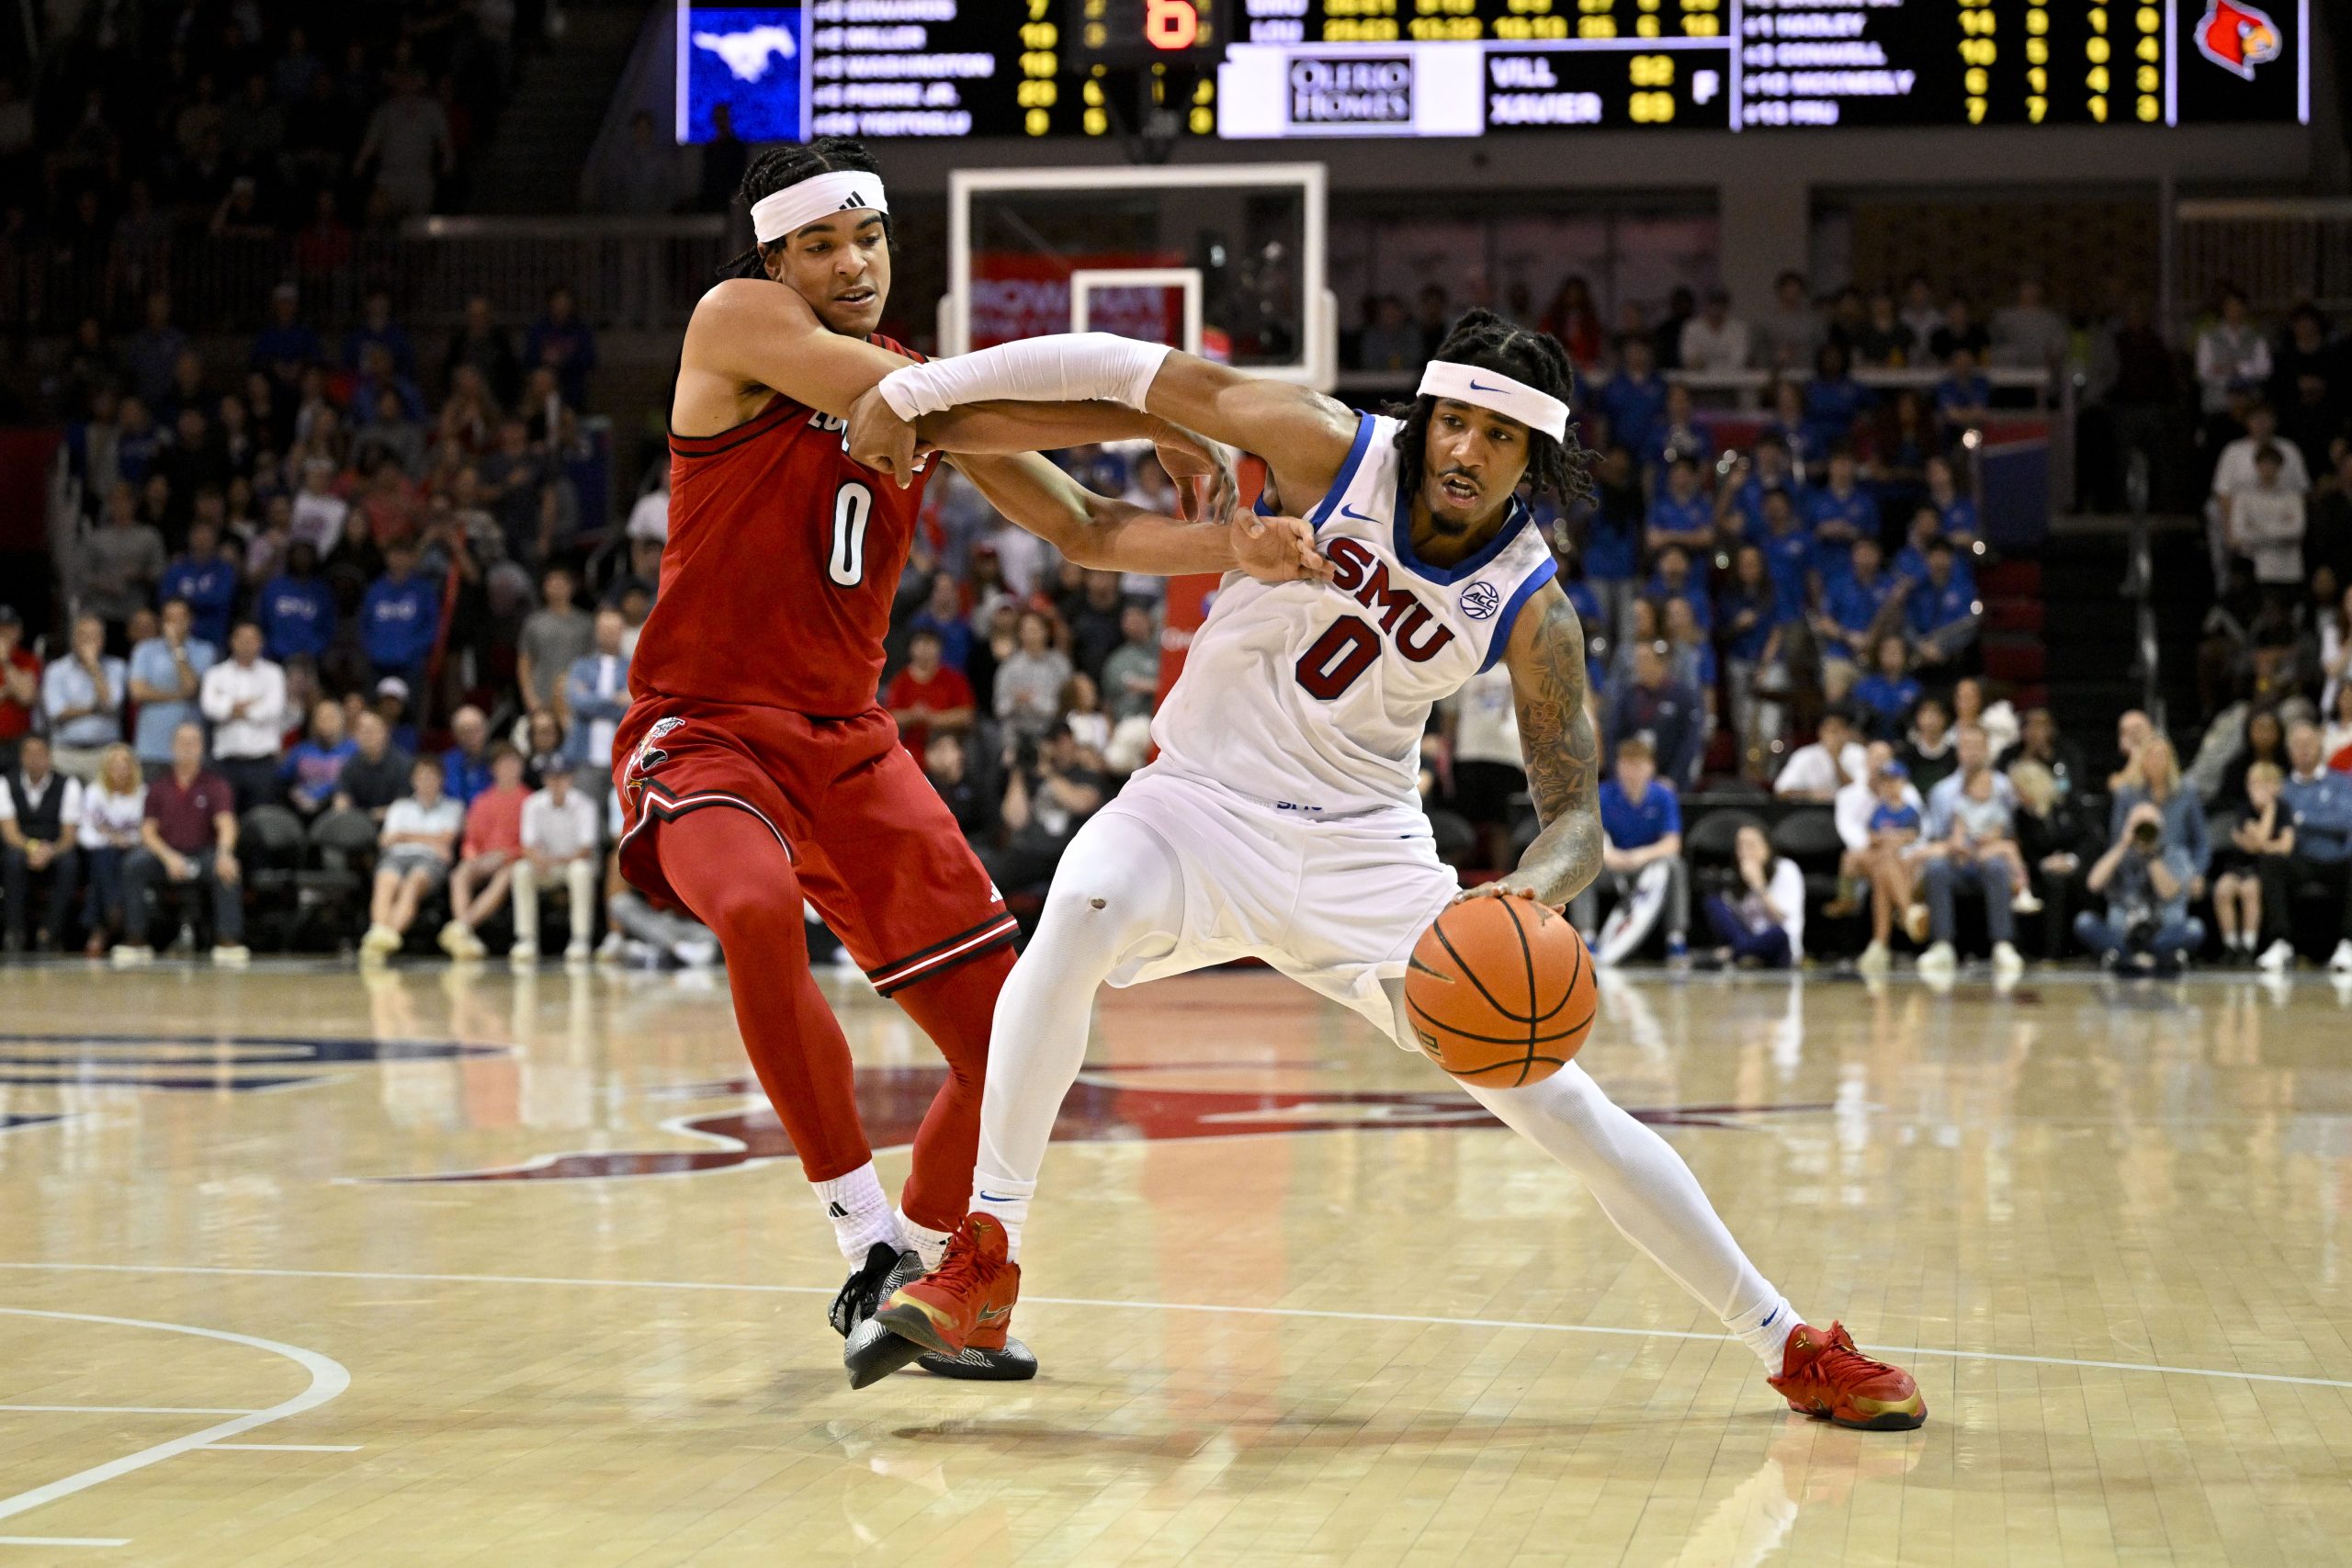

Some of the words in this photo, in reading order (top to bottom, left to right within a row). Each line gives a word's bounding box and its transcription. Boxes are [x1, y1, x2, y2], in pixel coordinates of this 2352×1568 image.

[828, 480, 873, 587] 0
[1327, 537, 1455, 662] SMU
[1464, 592, 1498, 608] ACC
[1295, 615, 1382, 700] 0
